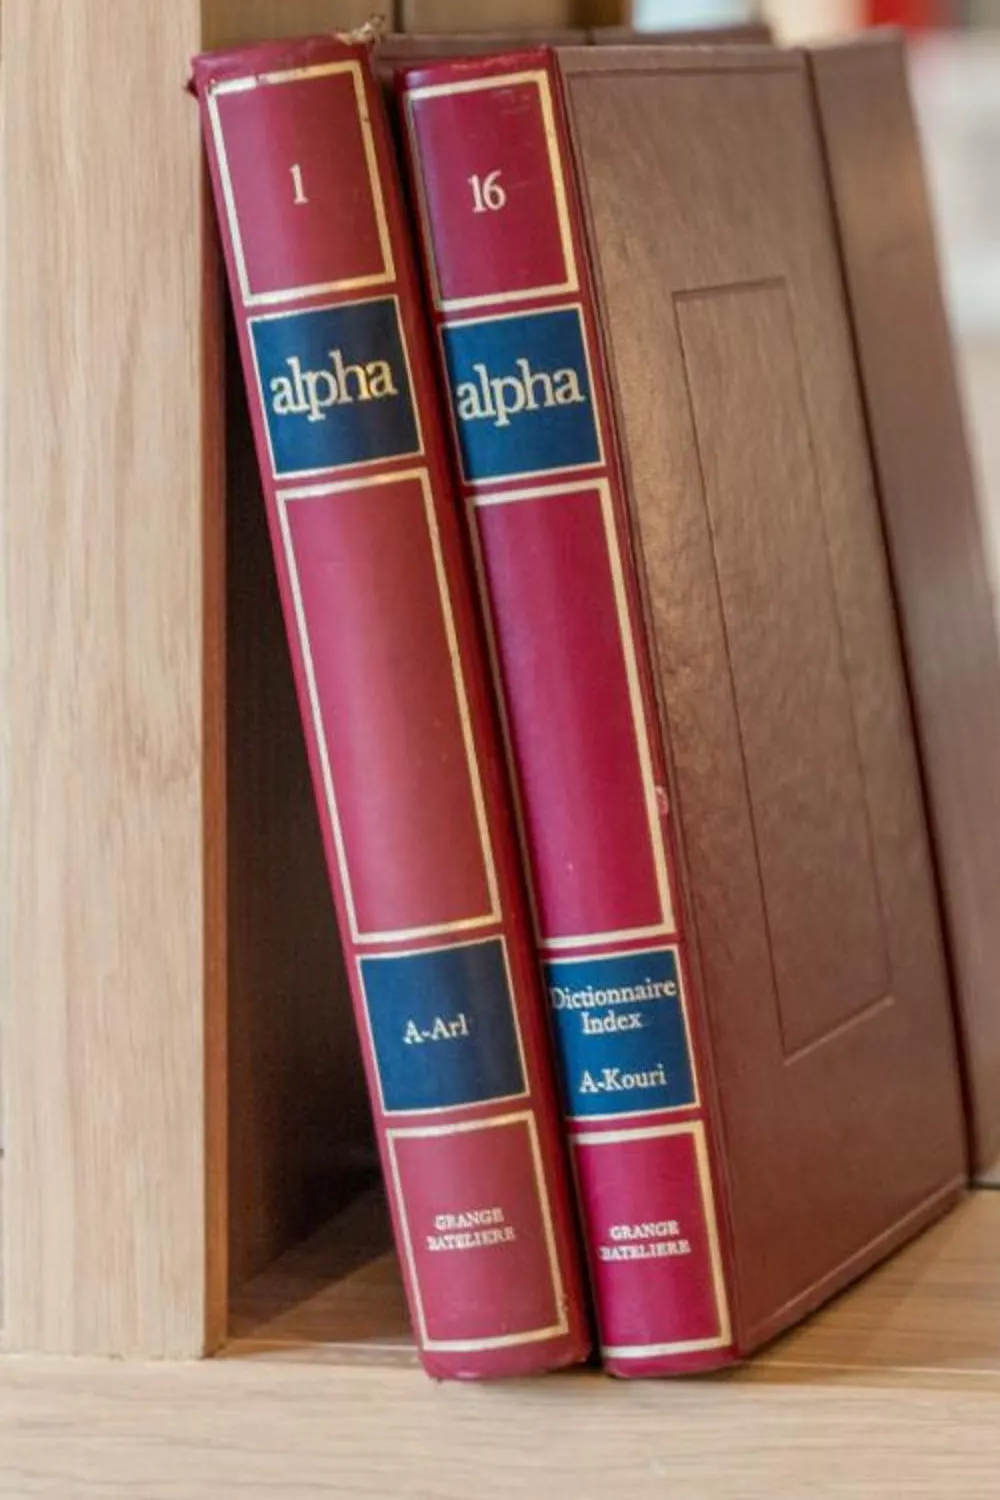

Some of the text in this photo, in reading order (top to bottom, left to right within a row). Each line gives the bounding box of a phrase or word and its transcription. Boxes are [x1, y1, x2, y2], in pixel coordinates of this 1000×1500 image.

[289, 163, 308, 204] 1
[467, 170, 507, 212] 16
[270, 349, 398, 421] alpha
[457, 358, 586, 428] alpha
[551, 977, 677, 1010] Dictionnaire
[581, 1010, 643, 1035] Index
[580, 1063, 667, 1094] A-Kouri
[434, 1208, 504, 1230] GRANGE
[609, 1220, 680, 1241] GRANGE
